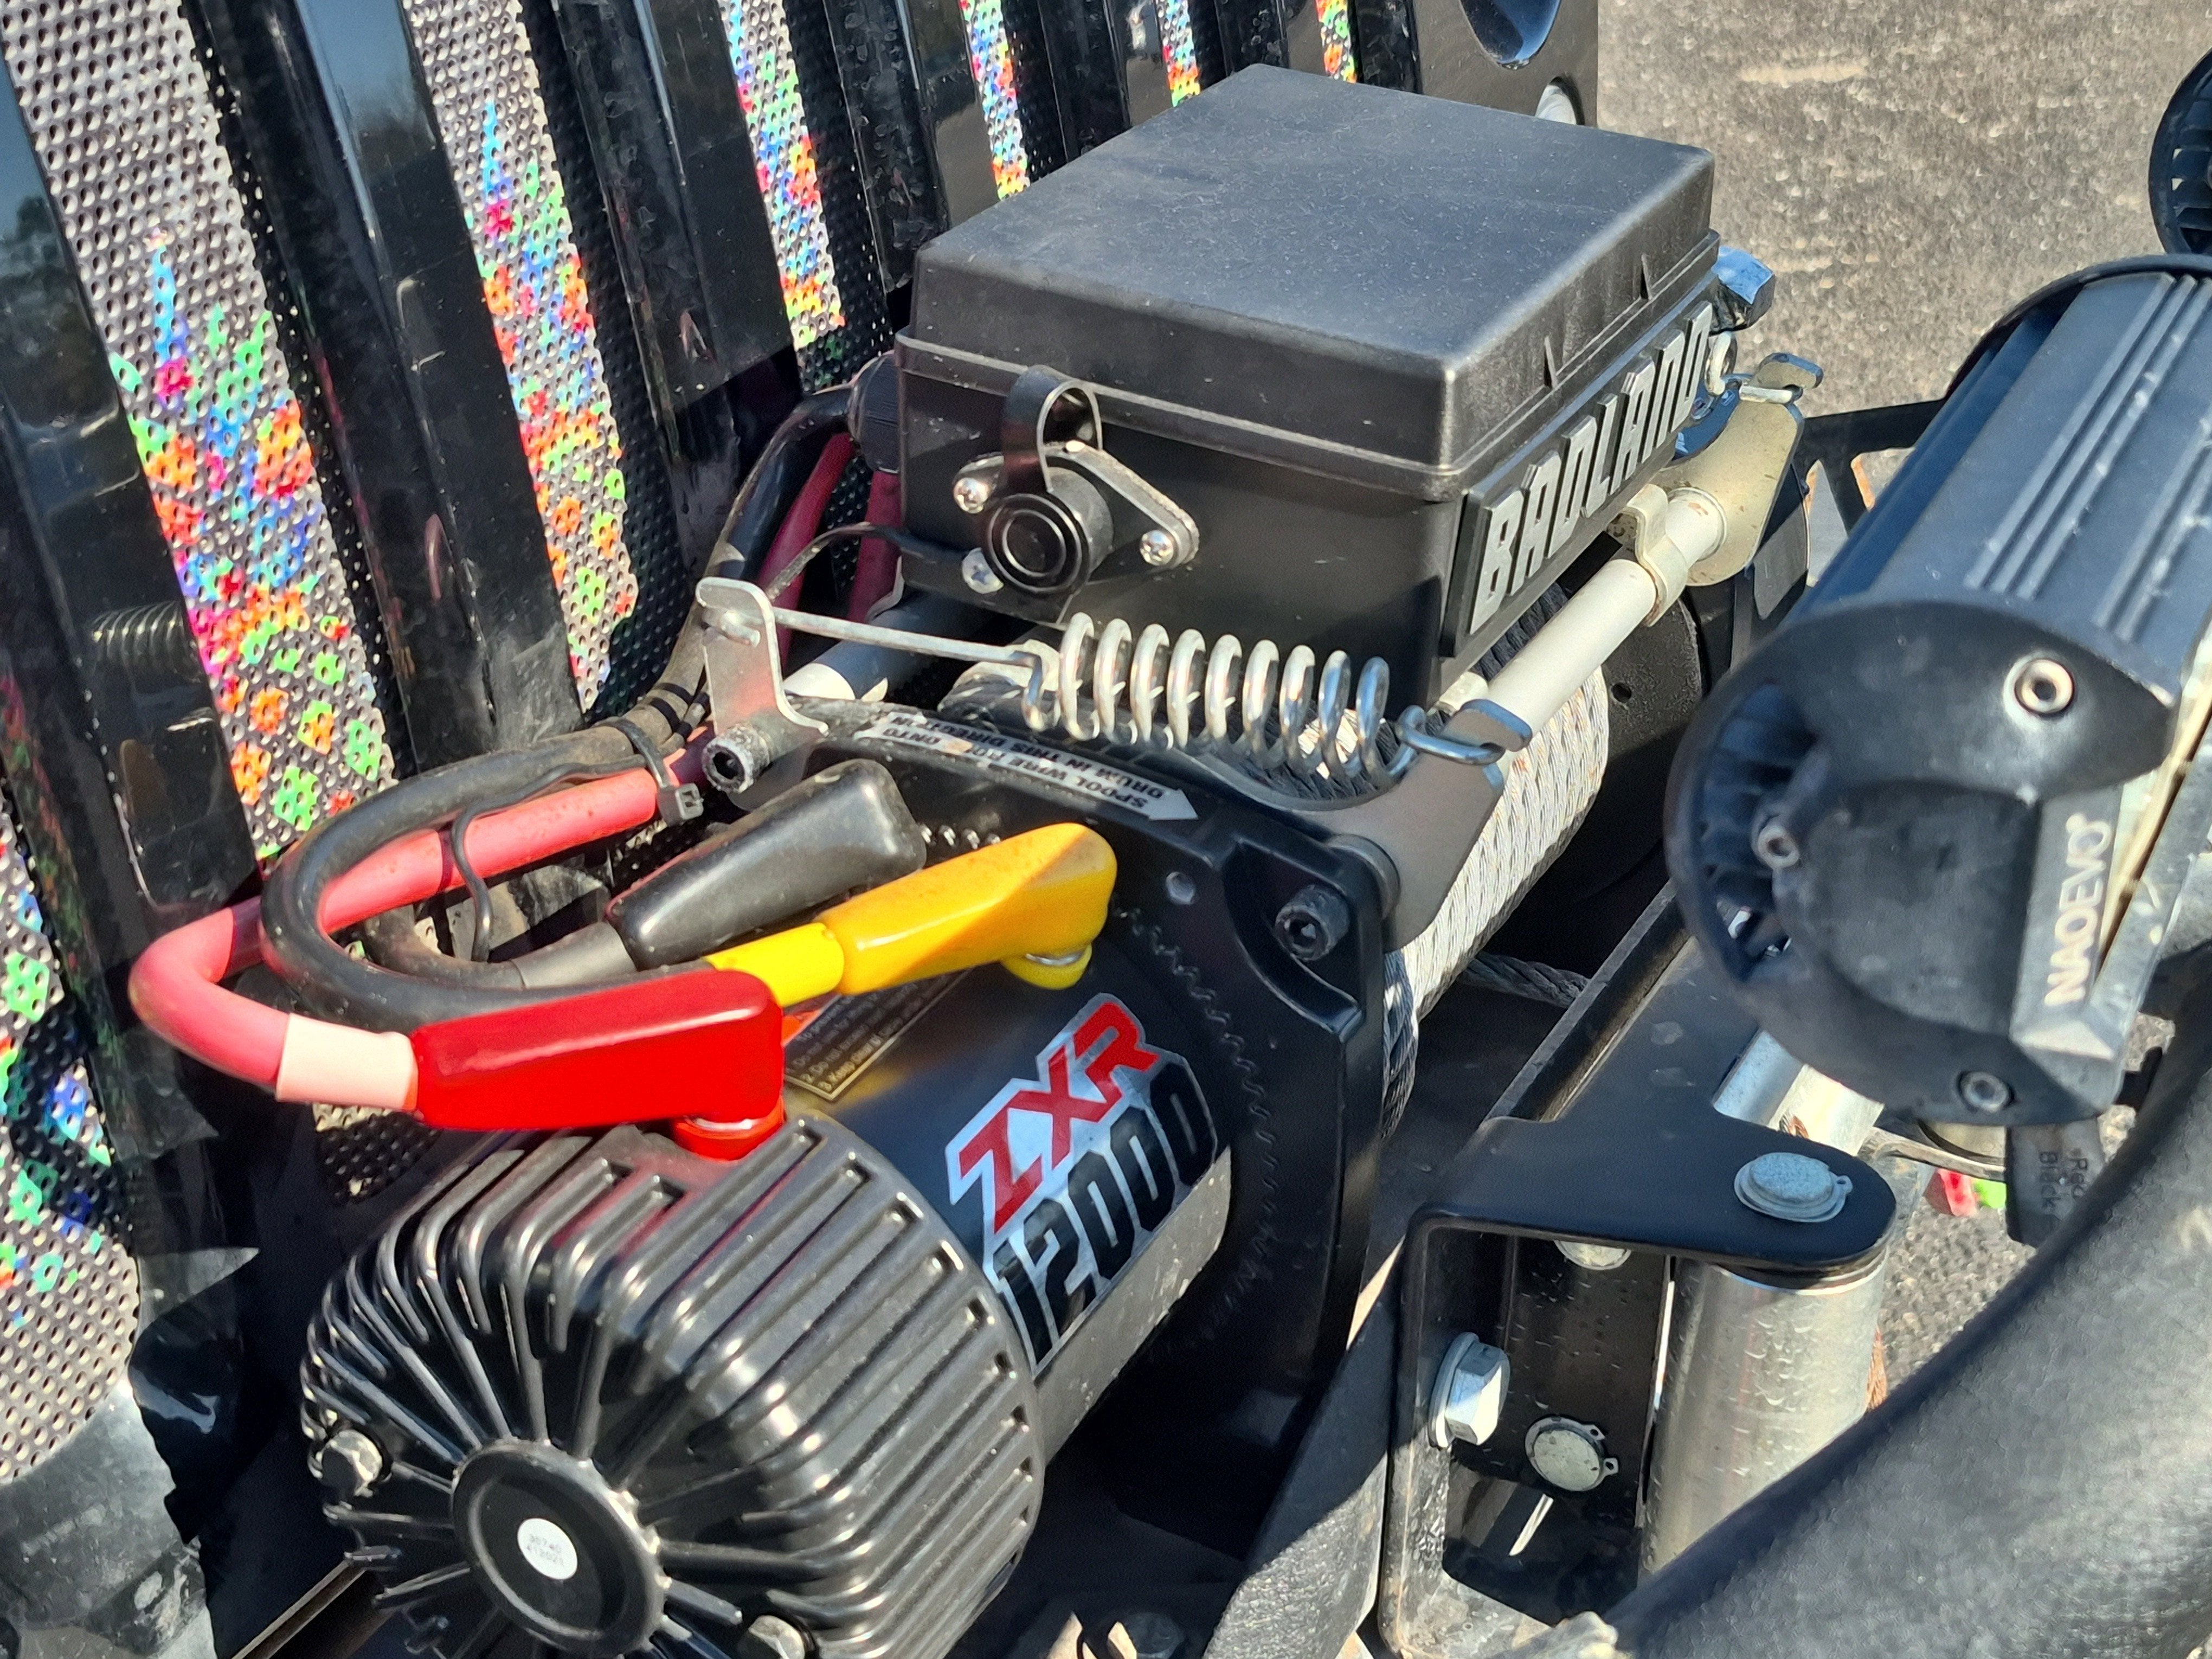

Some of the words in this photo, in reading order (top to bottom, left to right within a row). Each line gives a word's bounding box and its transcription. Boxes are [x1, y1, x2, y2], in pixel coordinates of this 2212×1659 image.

[1470, 301, 1712, 635] BADLAND
[883, 728, 942, 745] ONTO
[1010, 742, 1062, 763] THIS
[1009, 758, 1067, 781] WIRE
[1064, 758, 1092, 773] IN
[1075, 775, 1149, 809] SPOOL
[1095, 768, 1165, 800] DRUM
[2044, 813, 2113, 1007] NAOEVO
[958, 1002, 1160, 1234] ZXR
[993, 1063, 1216, 1366] 12000
